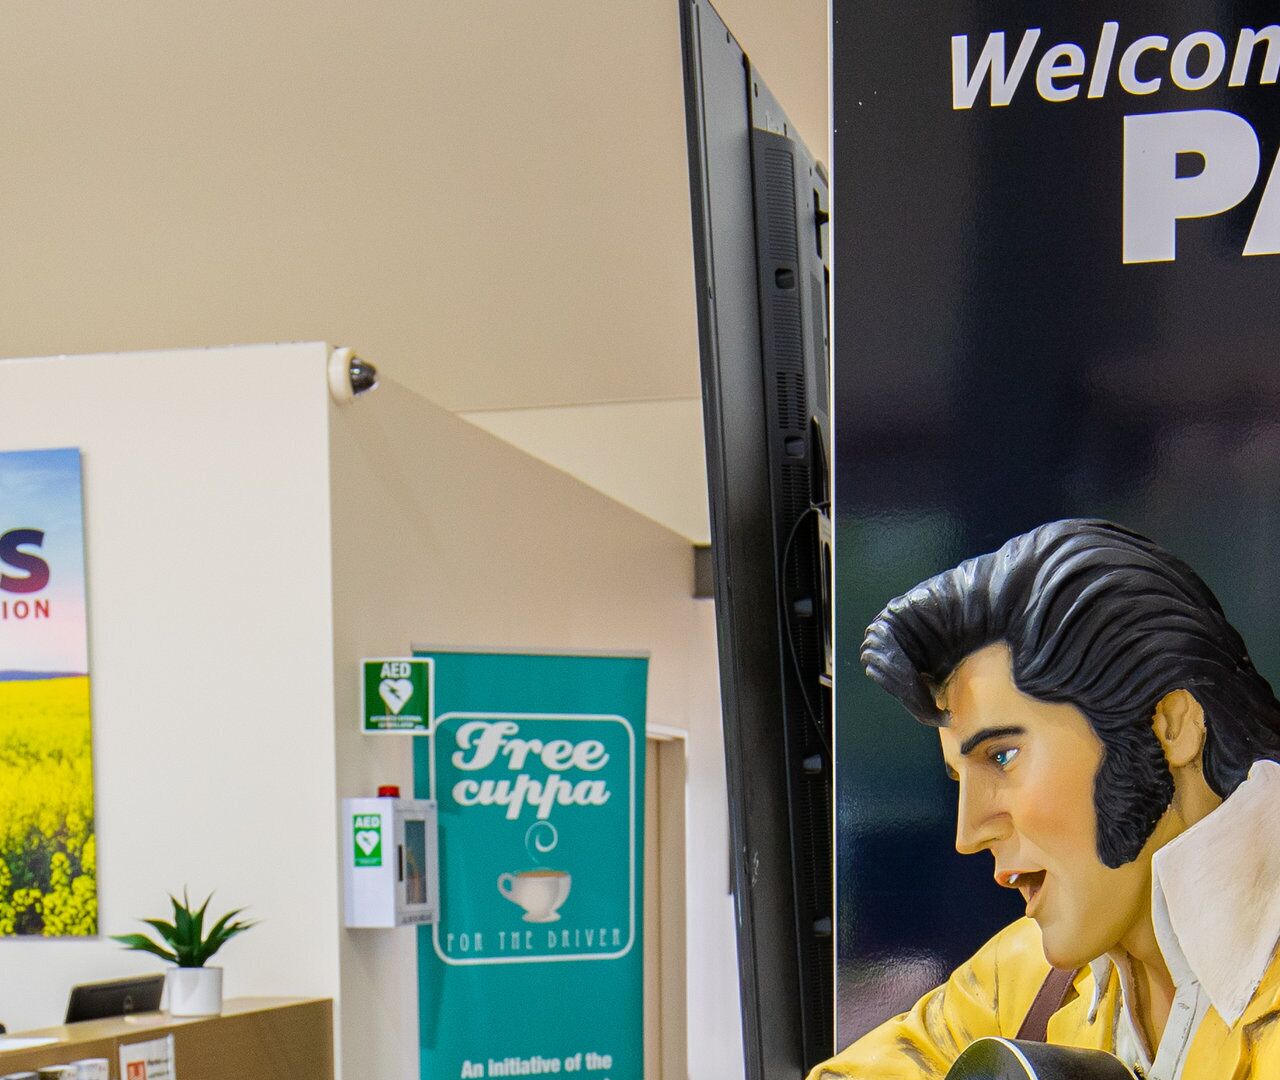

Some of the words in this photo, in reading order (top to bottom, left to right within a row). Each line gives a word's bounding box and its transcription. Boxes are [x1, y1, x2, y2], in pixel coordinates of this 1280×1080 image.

[380, 662, 412, 679] AED
[451, 720, 610, 772] Free
[451, 773, 611, 821] cuppa
[355, 816, 380, 828] AED
[447, 932, 483, 952] FOR
[499, 930, 533, 950] THE
[547, 927, 620, 948] DRIVER
[460, 1060, 485, 1079] An
[487, 1055, 561, 1077] initiative
[564, 1052, 582, 1072] of
[584, 1052, 613, 1071] the
